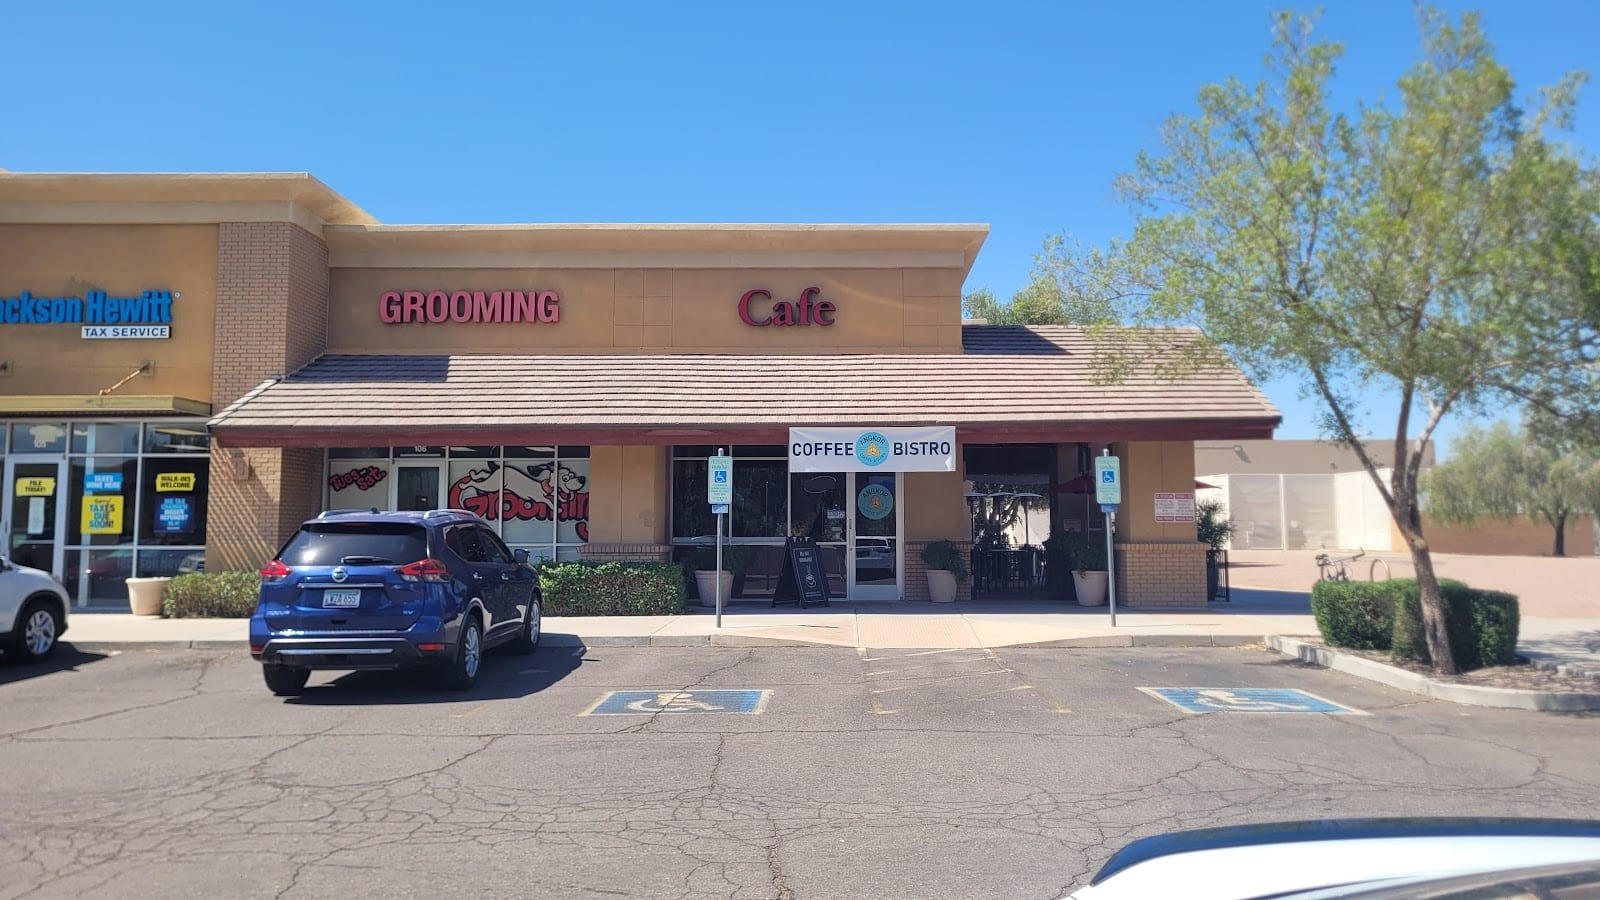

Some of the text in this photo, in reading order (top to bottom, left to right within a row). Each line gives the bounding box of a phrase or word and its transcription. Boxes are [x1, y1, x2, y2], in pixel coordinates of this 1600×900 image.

[0, 290, 172, 323] ckson Hewitt
[379, 290, 560, 324] GROOMING
[738, 287, 836, 326] Cafe
[84, 328, 167, 337] TAX SERVICE
[860, 435, 886, 446] ANGKOR
[414, 445, 427, 453] 106
[792, 441, 951, 456] COFFEE BISTRO
[89, 504, 115, 512] TAXES
[94, 512, 109, 520] DUE
[89, 520, 114, 528] SOON!
